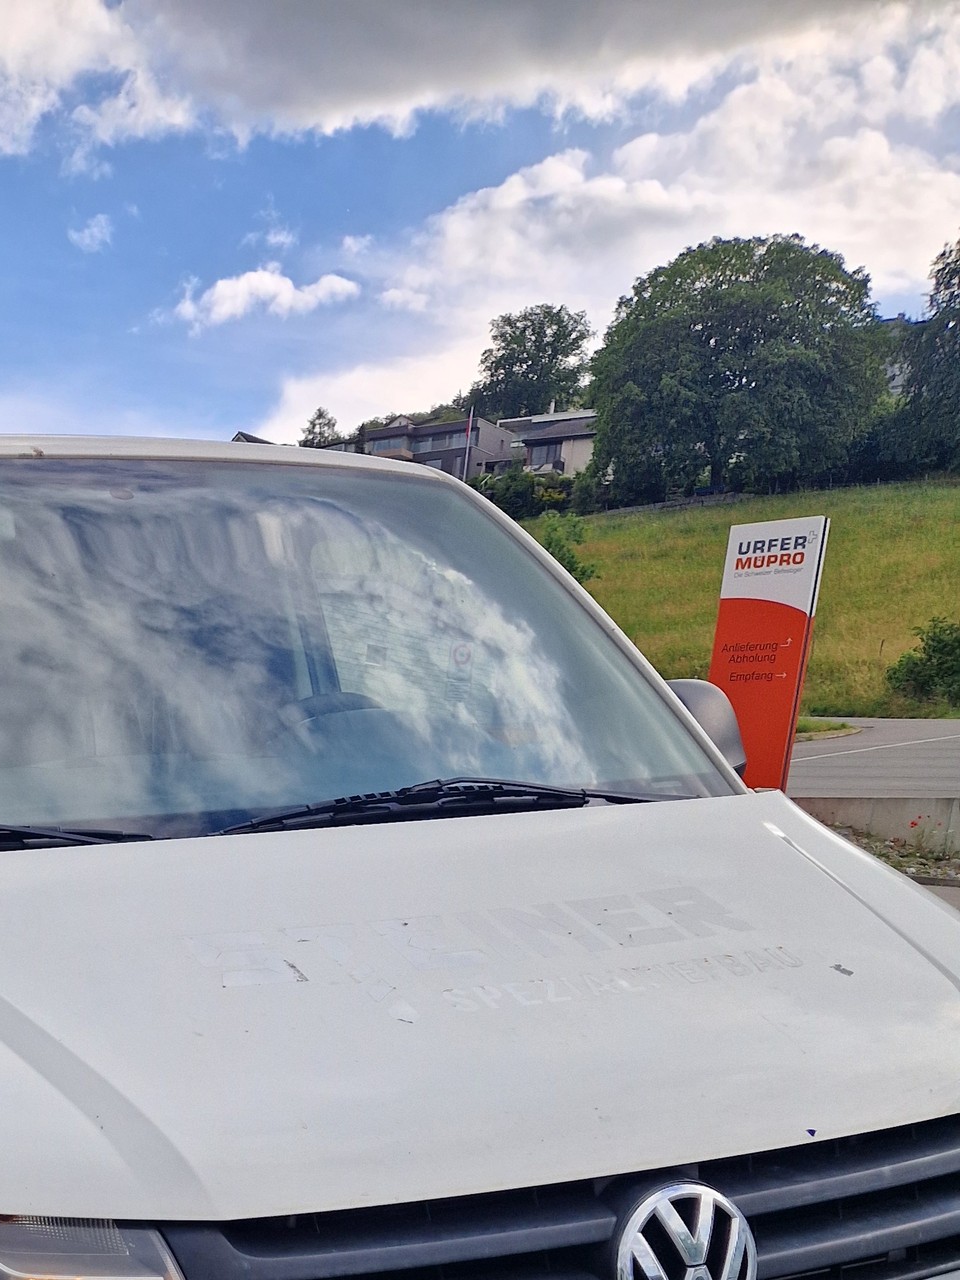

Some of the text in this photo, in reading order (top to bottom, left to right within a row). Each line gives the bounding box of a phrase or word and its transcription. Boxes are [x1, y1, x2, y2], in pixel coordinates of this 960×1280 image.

[738, 535, 807, 555] URFER
[735, 552, 805, 570] MÜPRO
[721, 641, 779, 653] Anlieferung
[728, 653, 777, 664] Abholung
[729, 671, 774, 682] Empfang
